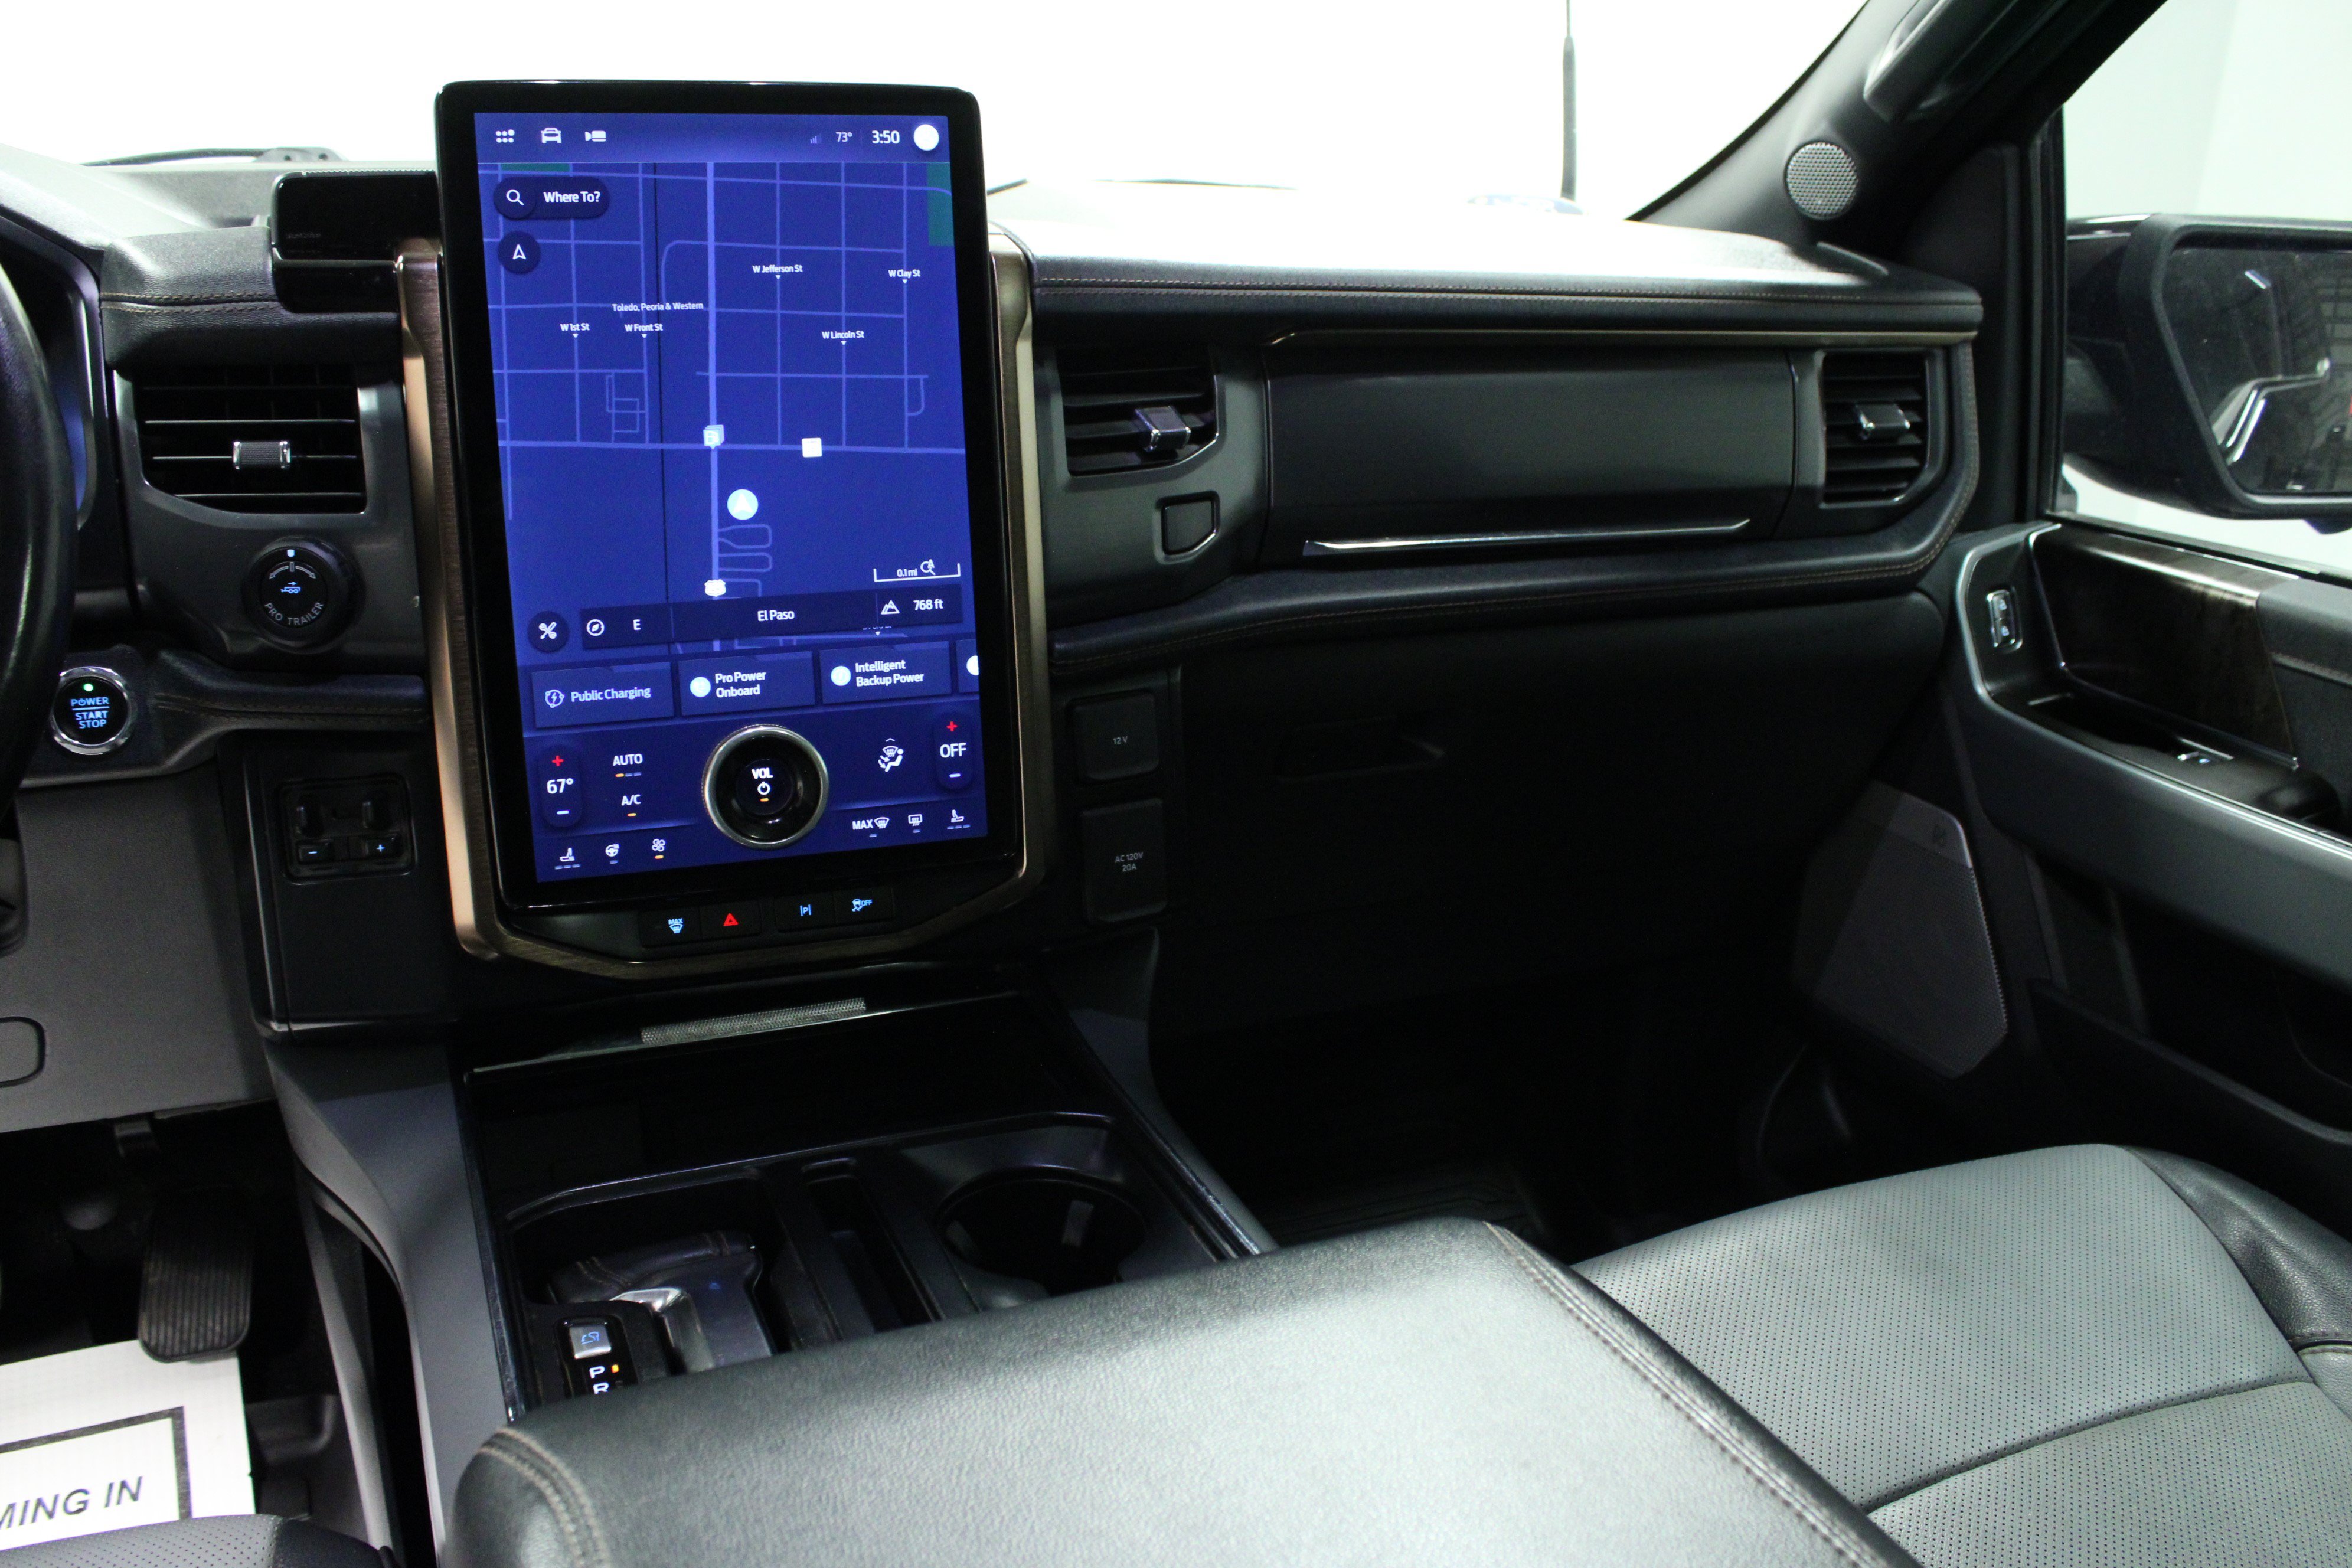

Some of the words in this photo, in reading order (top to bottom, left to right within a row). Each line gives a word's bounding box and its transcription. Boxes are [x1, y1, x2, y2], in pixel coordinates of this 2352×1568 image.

[836, 132, 852, 142] 73°
[872, 130, 900, 145] 3:50
[544, 191, 579, 203] Where
[581, 191, 601, 203] To?
[762, 264, 794, 273] Jefferson
[795, 264, 803, 273] St
[897, 270, 912, 279] Clay
[913, 269, 920, 277] St
[612, 303, 640, 312] Toledo,
[641, 302, 664, 311] Peoria
[672, 302, 704, 311] Western
[634, 324, 654, 332] Front
[831, 331, 854, 339] Lincoln
[913, 599, 932, 611] 768
[934, 599, 943, 609] ft
[264, 603, 283, 621] PRO
[287, 602, 324, 625] TRAILER
[757, 611, 768, 621] El
[770, 610, 794, 620] Paso
[633, 620, 641, 631] E
[855, 660, 906, 673] Intelligent
[715, 674, 733, 684] Pro
[734, 672, 766, 682] Power
[856, 675, 892, 688] Backup
[894, 673, 924, 684] Power
[571, 691, 603, 703] Public
[605, 687, 651, 701] Charging
[716, 685, 760, 698] Onboard
[71, 697, 109, 706] POWER
[76, 711, 108, 720] START
[79, 720, 107, 729] STOP
[940, 743, 966, 759] OFF
[612, 754, 643, 766] AUTO
[751, 767, 773, 779] VOL
[547, 778, 574, 795] 67°
[621, 795, 641, 806] A/C
[852, 819, 873, 830] MAX
[1126, 852, 1144, 861] 120V
[589, 1366, 605, 1378] P
[593, 1382, 609, 1394] R
[104, 1476, 142, 1508] IN
